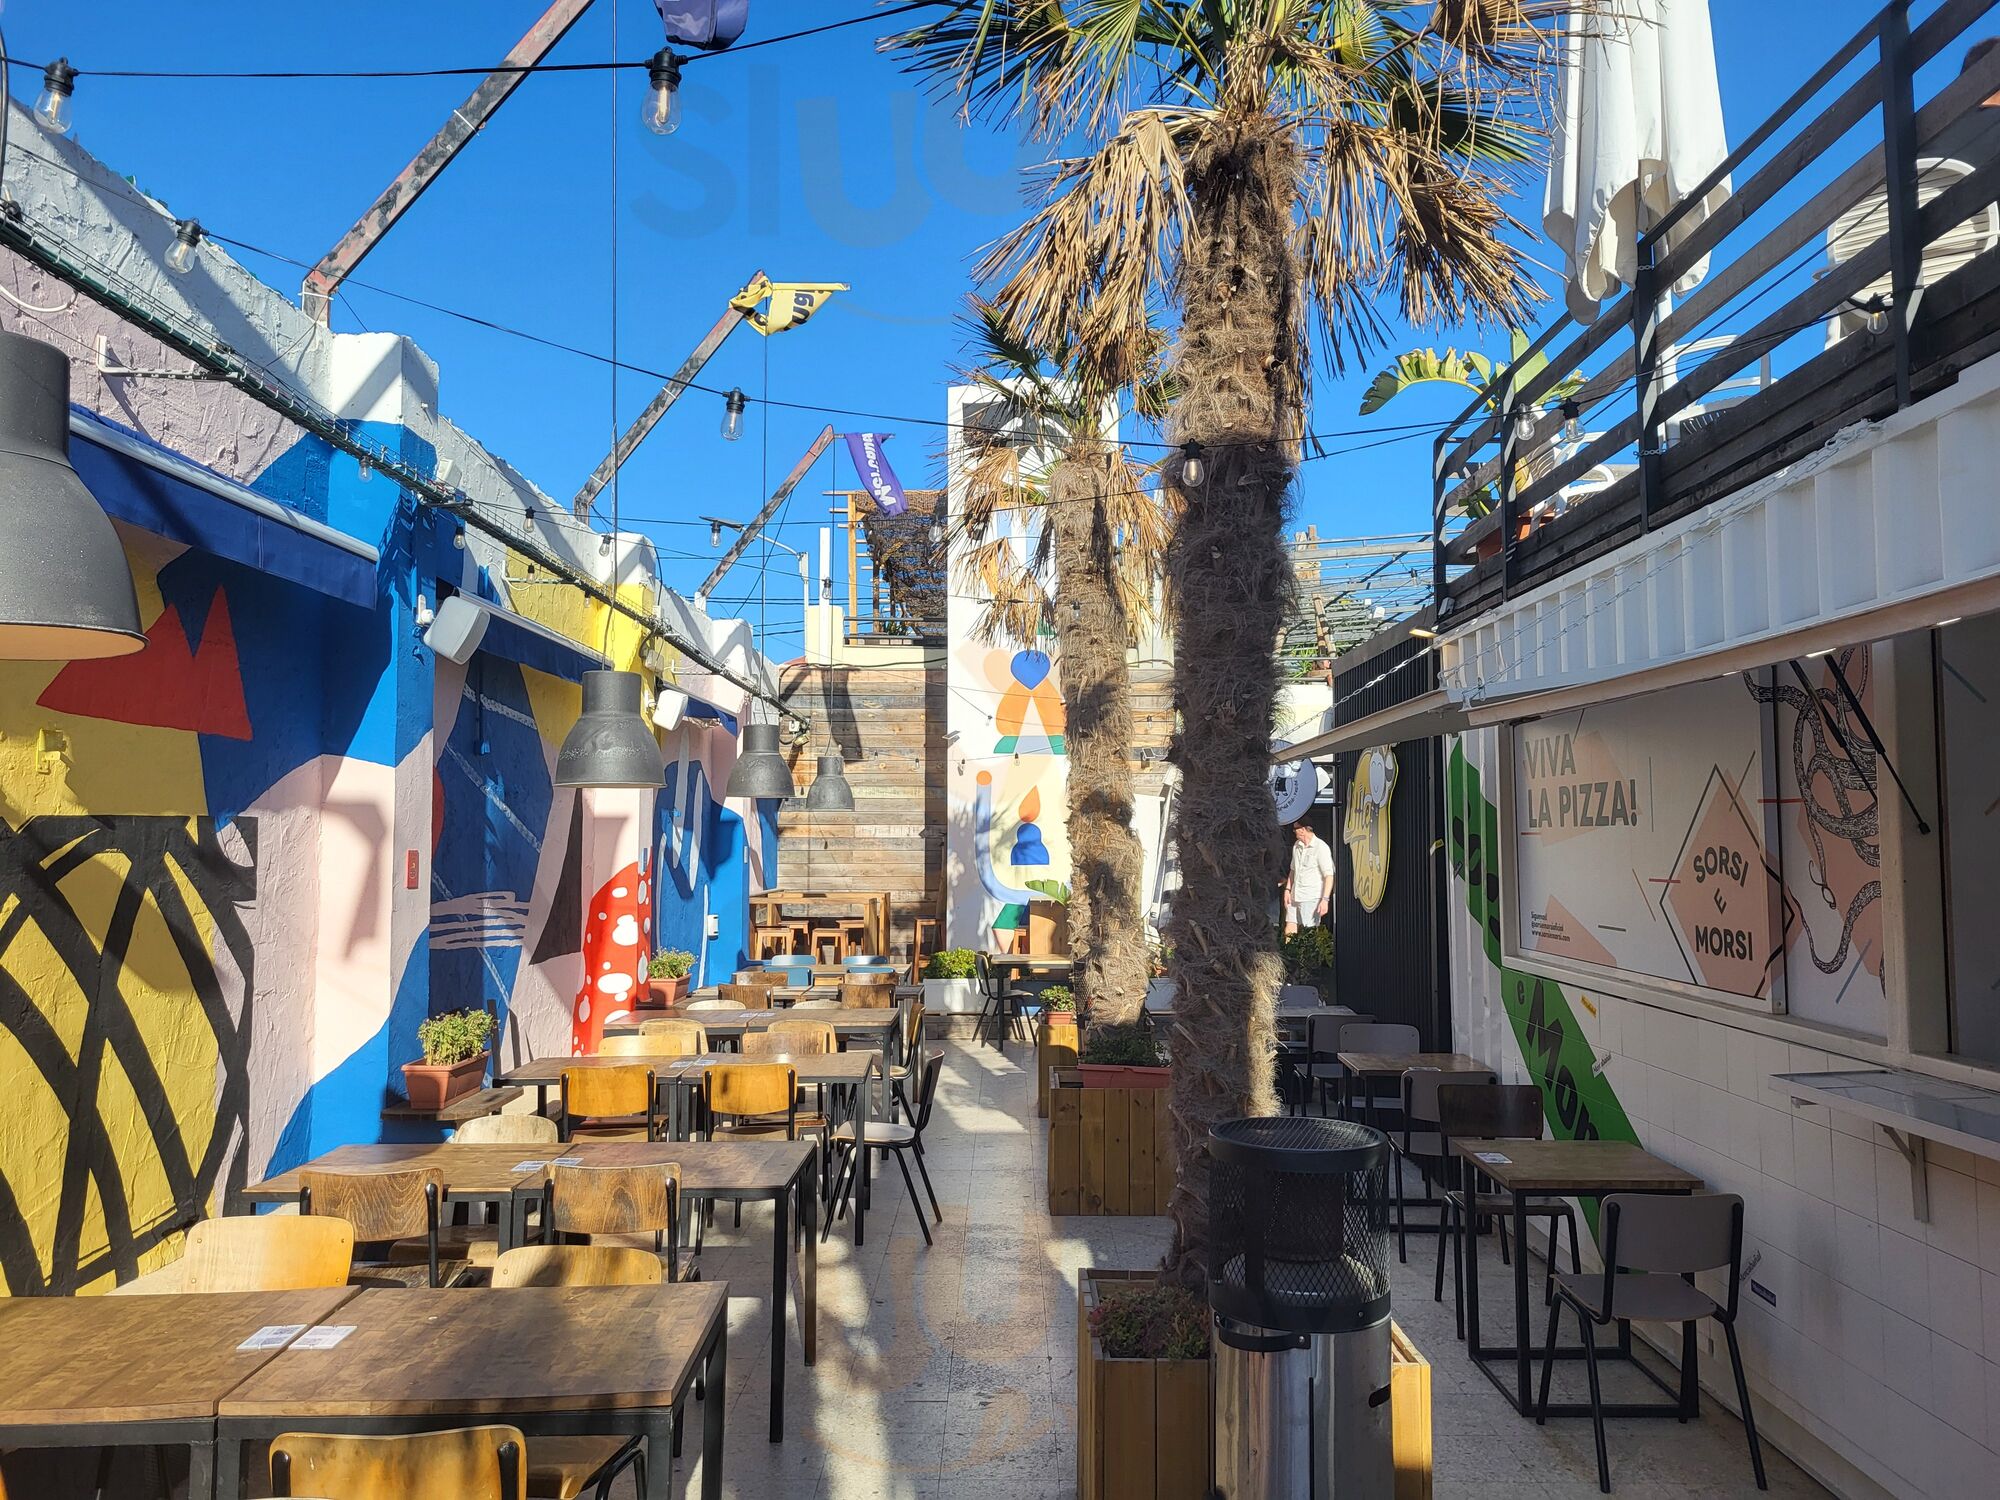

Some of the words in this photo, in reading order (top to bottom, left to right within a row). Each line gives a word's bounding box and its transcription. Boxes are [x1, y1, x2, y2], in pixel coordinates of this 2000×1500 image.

[1525, 733, 1577, 779] VIVA
[1528, 788, 1552, 828] LA
[1559, 779, 1638, 828] PIZZA!
[1693, 845, 1749, 888] SORSI
[1713, 887, 1727, 915] E
[1695, 925, 1753, 961] MORSI
